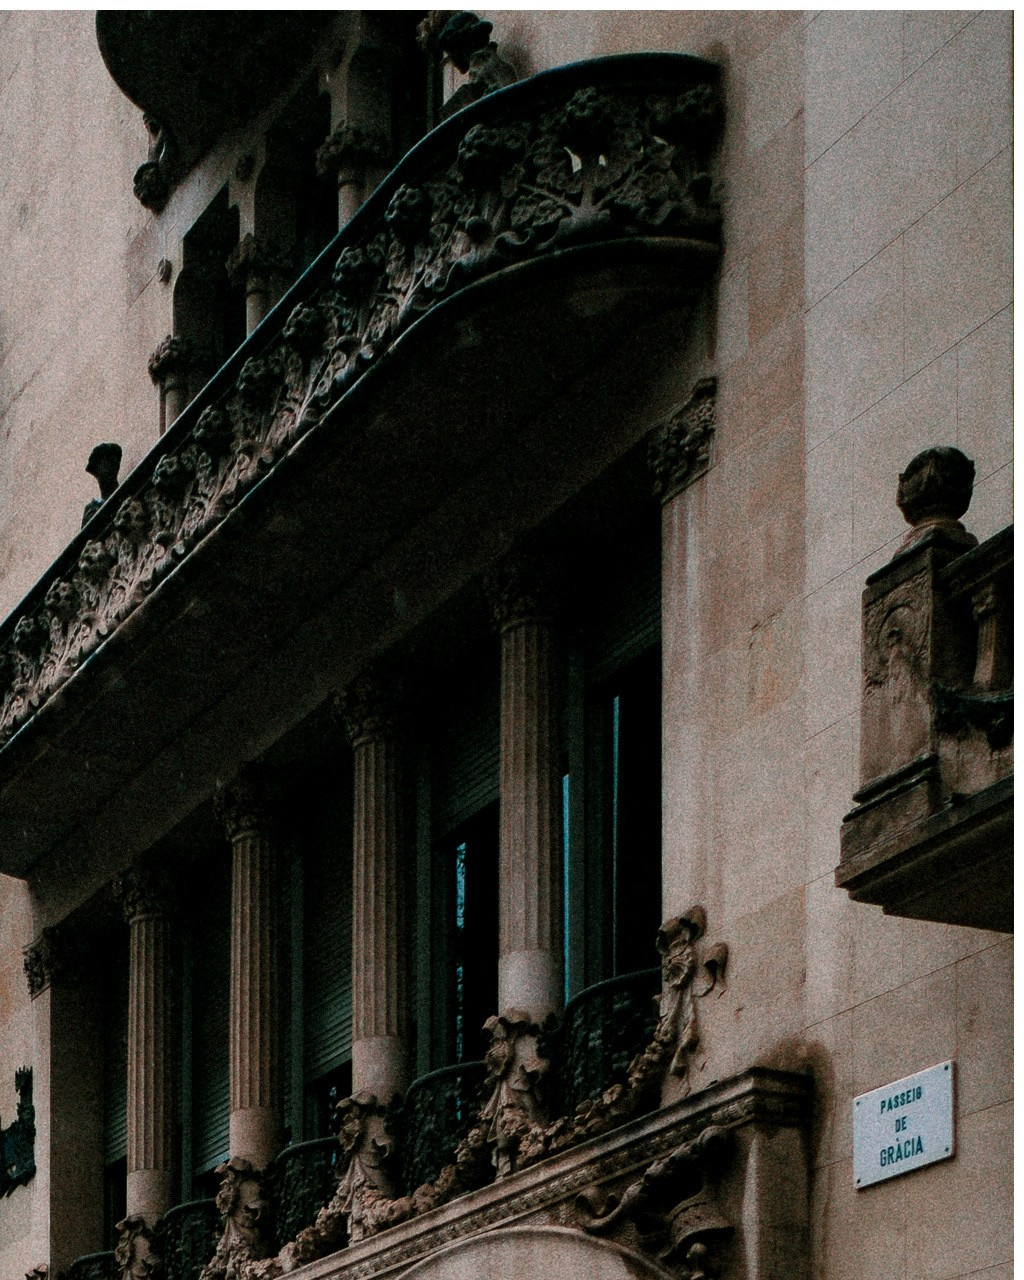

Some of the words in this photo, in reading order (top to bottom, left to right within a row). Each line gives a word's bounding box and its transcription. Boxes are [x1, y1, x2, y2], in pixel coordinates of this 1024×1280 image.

[879, 1086, 923, 1115] PASSEIG
[894, 1116, 908, 1134] DE
[879, 1136, 924, 1167] GRÀCIA
